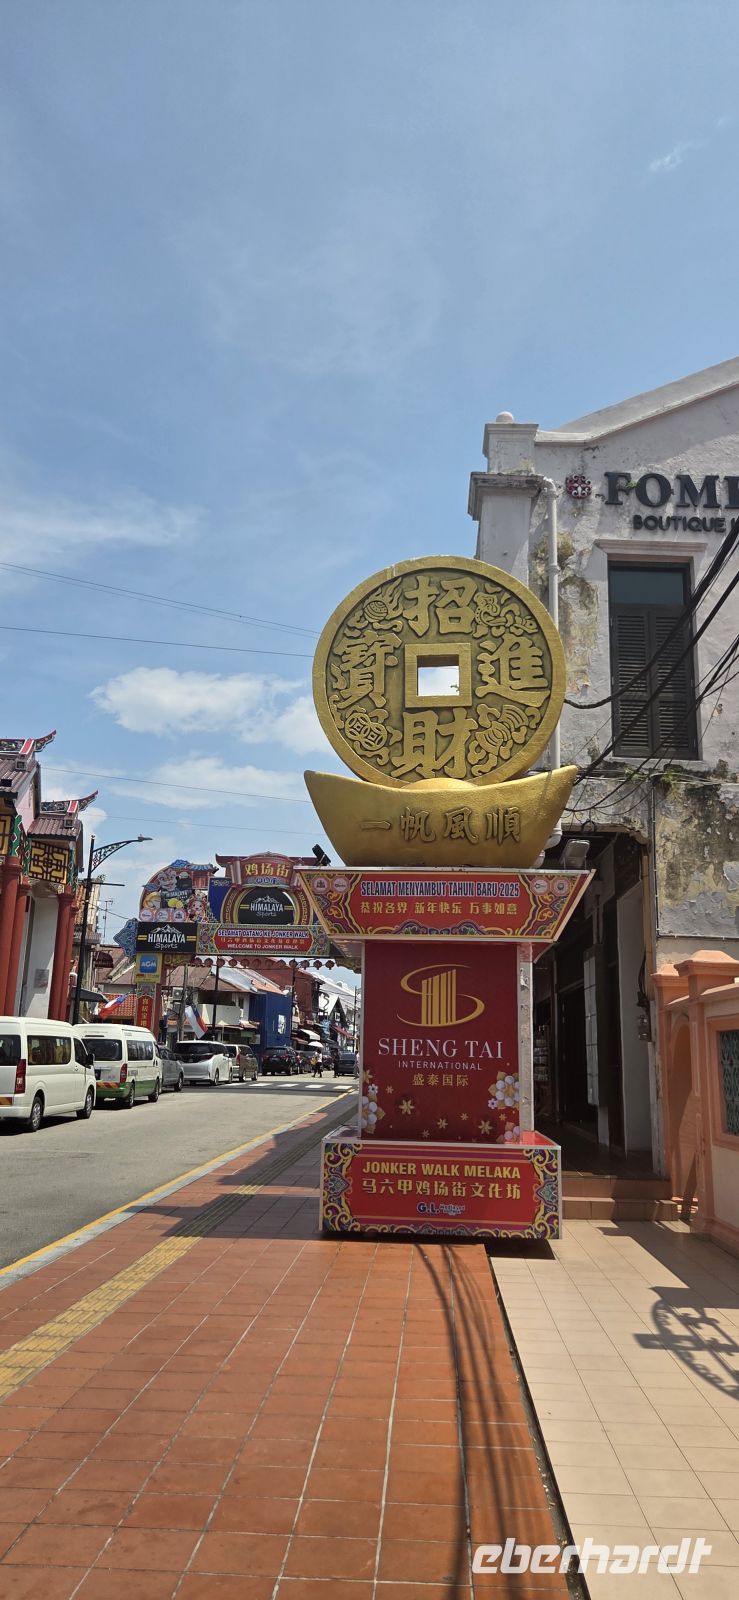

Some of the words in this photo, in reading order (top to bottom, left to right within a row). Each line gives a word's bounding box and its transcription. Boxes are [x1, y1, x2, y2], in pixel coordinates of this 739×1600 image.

[633, 514, 726, 533] BOUTIQUE
[361, 806, 522, 845] 一帆風順
[245, 863, 290, 877] 鸡场街
[361, 880, 396, 897] SELAMAT
[397, 880, 446, 897] MENYAMBUT
[447, 881, 475, 897] TAHUN
[475, 881, 498, 898] BARU
[498, 882, 520, 898] 2025
[250, 902, 284, 912] HIMALAYA
[360, 901, 409, 914] 恭祝各界
[414, 901, 463, 915] 新年快乐
[469, 902, 518, 915] 万事如意
[147, 933, 186, 943] HIMALAYA
[242, 929, 263, 937] DATANG
[271, 930, 293, 938] JONKER
[293, 930, 309, 938] WALK
[154, 942, 178, 950] Sports
[378, 1037, 458, 1057] SHENG
[464, 1040, 504, 1059] TAI
[398, 1060, 483, 1071] INTERNATIONAL
[412, 1073, 469, 1087] 盛泰国际
[362, 1161, 417, 1175] JONKER
[421, 1163, 459, 1177] WALK
[464, 1164, 521, 1179] MELAKA
[362, 1178, 521, 1200] 马六甲鸡场街文化坊
